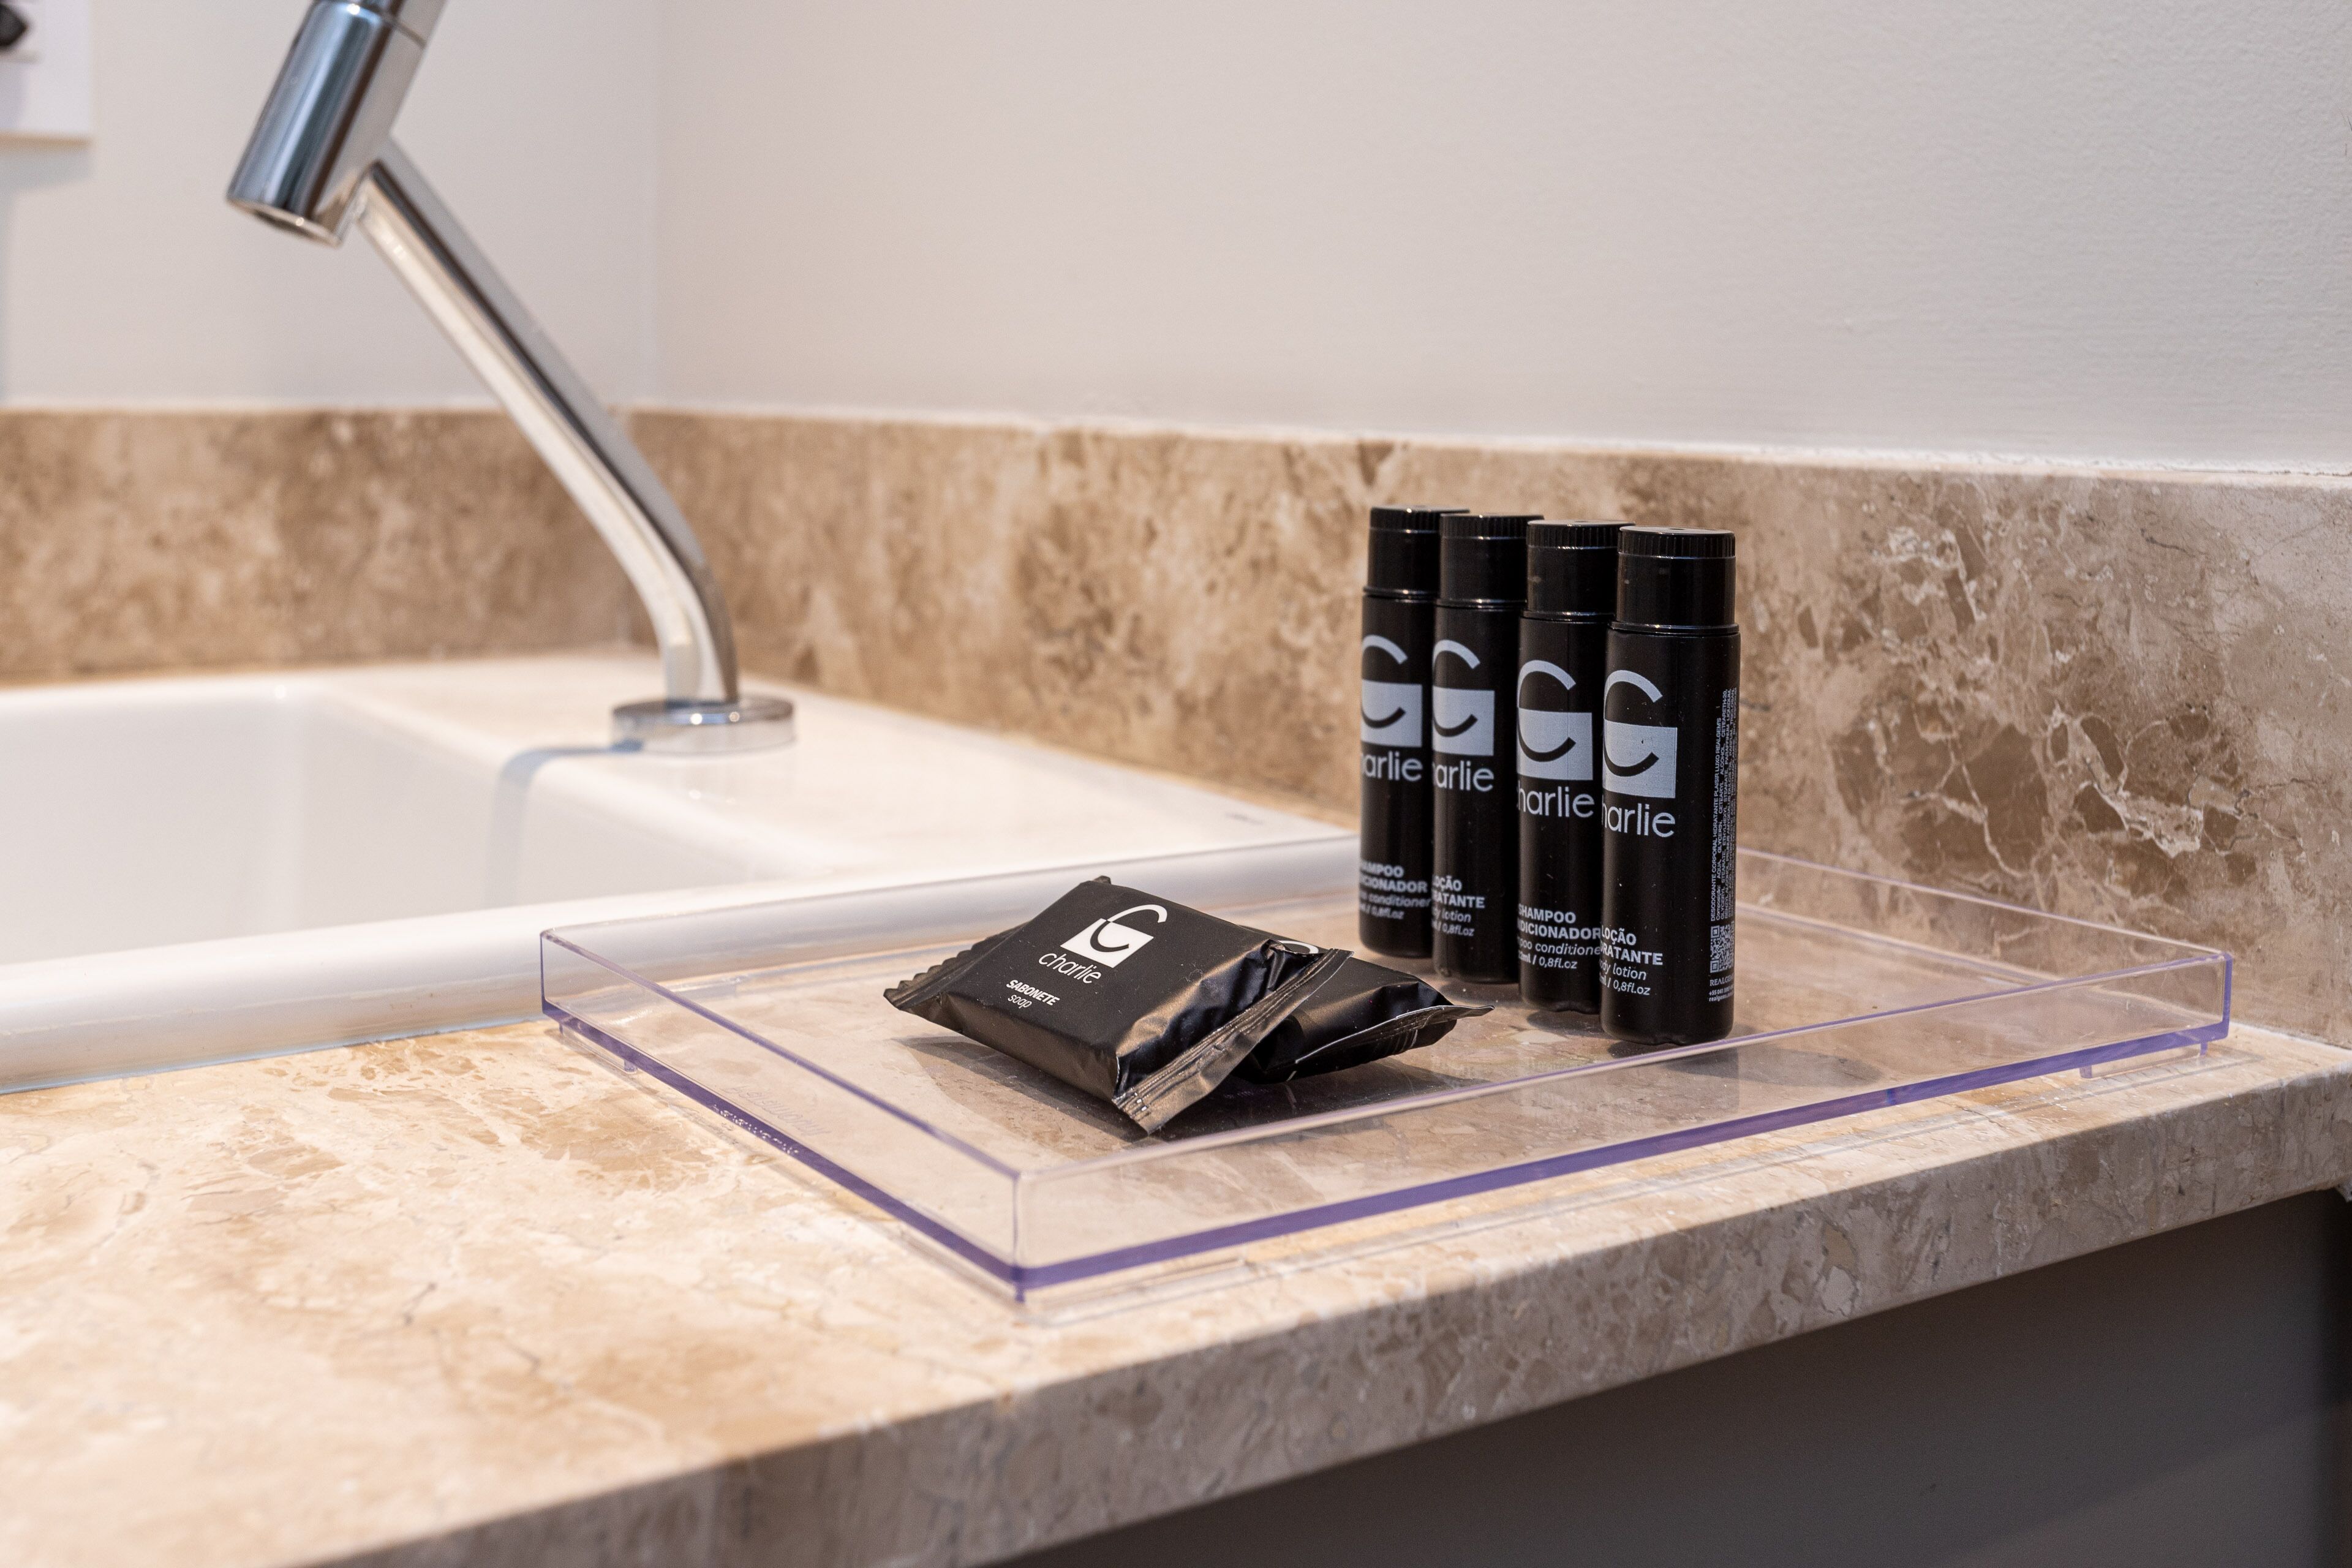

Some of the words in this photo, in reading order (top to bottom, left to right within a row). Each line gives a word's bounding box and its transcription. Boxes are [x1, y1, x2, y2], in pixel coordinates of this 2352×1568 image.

[1362, 751, 1423, 781] arlie
[1433, 760, 1494, 791] arlie
[1517, 780, 1595, 818] harlie
[1601, 794, 1675, 837] harlie
[1432, 875, 1462, 891] OÇÃO
[1442, 908, 1471, 922] lotion
[1518, 903, 1576, 924] SHAMPOO
[1602, 925, 1637, 946] LOÇÃO
[1535, 943, 1601, 956] conditione
[1600, 939, 1663, 966] DRATANTE
[1038, 952, 1102, 984] charlie
[1600, 959, 1611, 975] ody
[1613, 962, 1646, 981] lotion
[1006, 979, 1060, 1006] SABONETE
[1008, 994, 1033, 1009] soap
